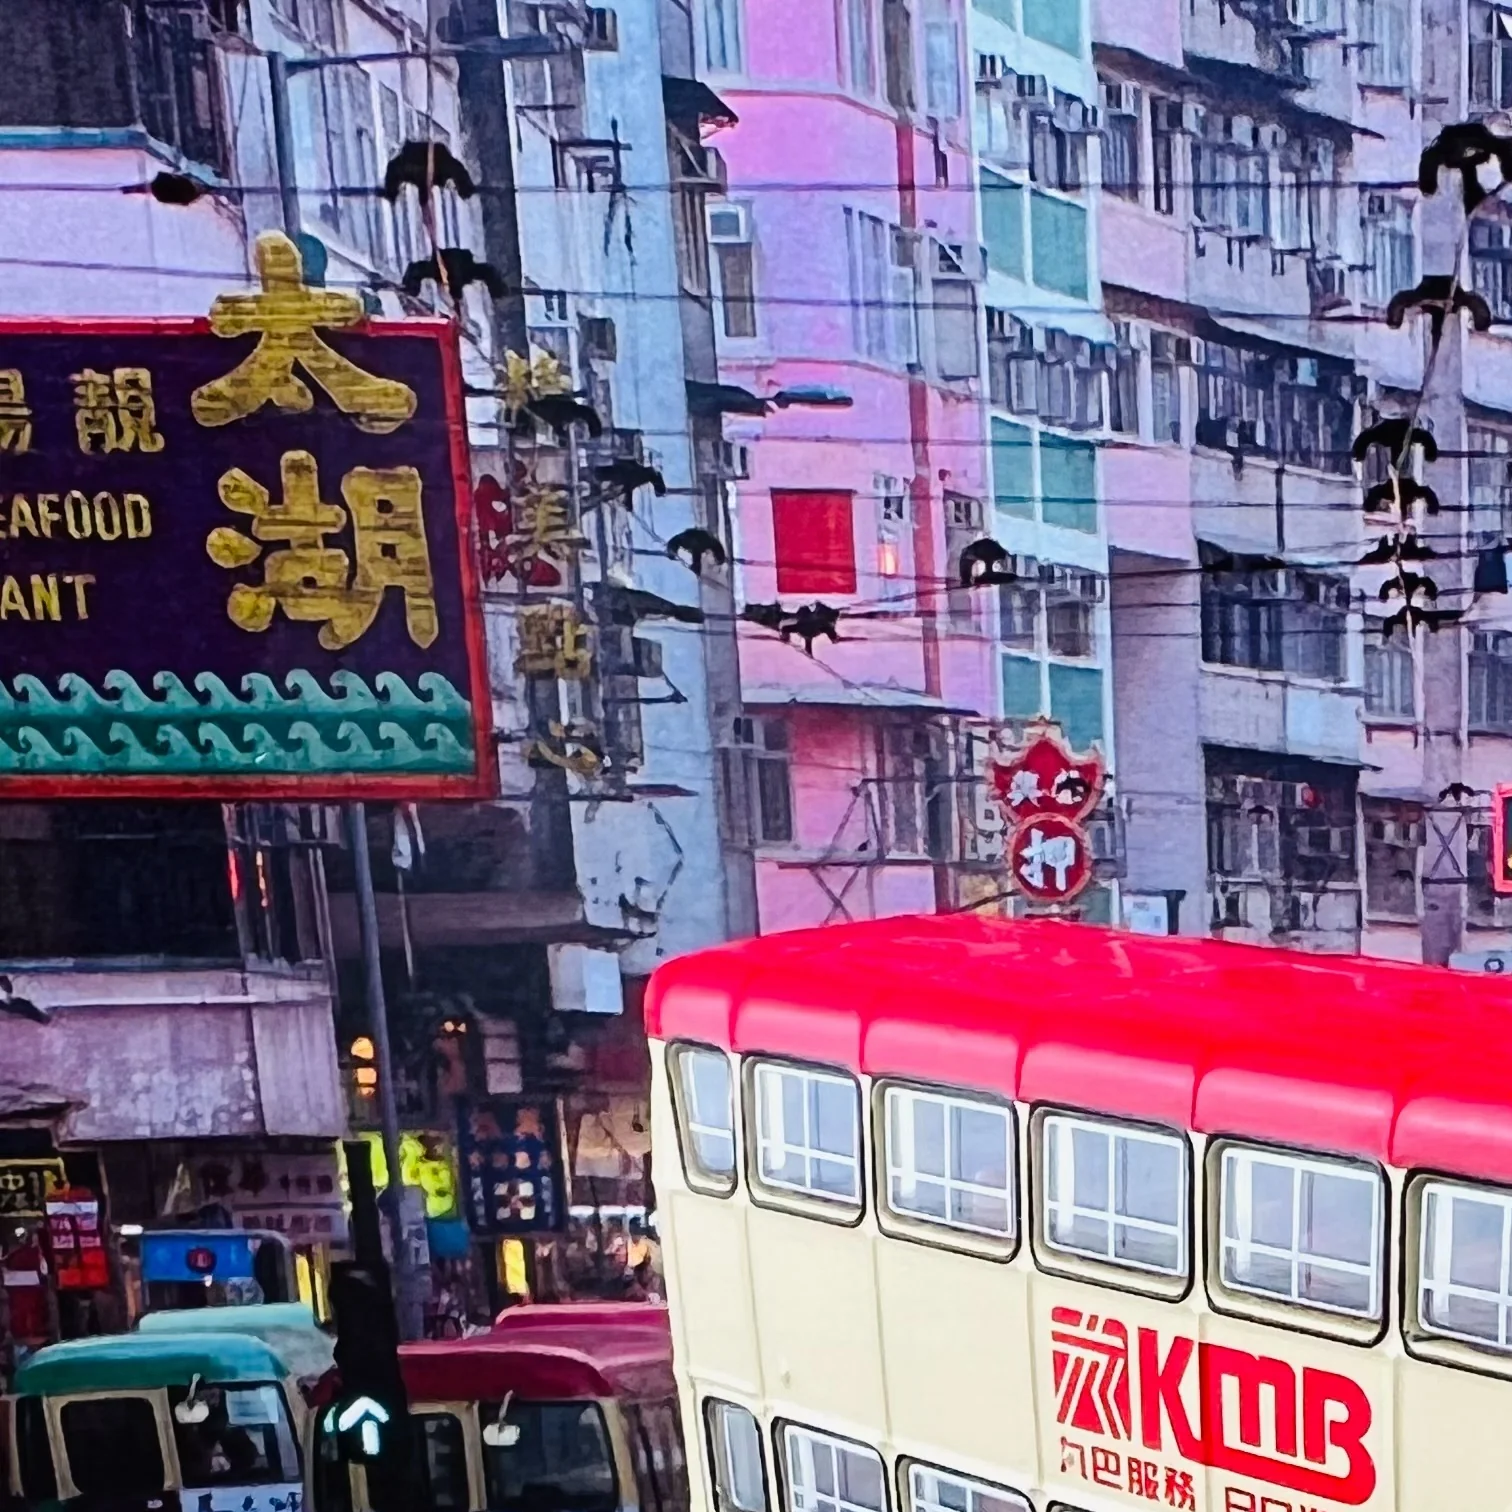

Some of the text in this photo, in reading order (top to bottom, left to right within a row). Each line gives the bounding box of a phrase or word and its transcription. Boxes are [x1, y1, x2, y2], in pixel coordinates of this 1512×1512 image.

[191, 230, 438, 650] 太湖
[0, 490, 152, 541] AFOOD
[1060, 1436, 1196, 1512] 九巴服務
[1138, 1326, 1377, 1505] KMB
